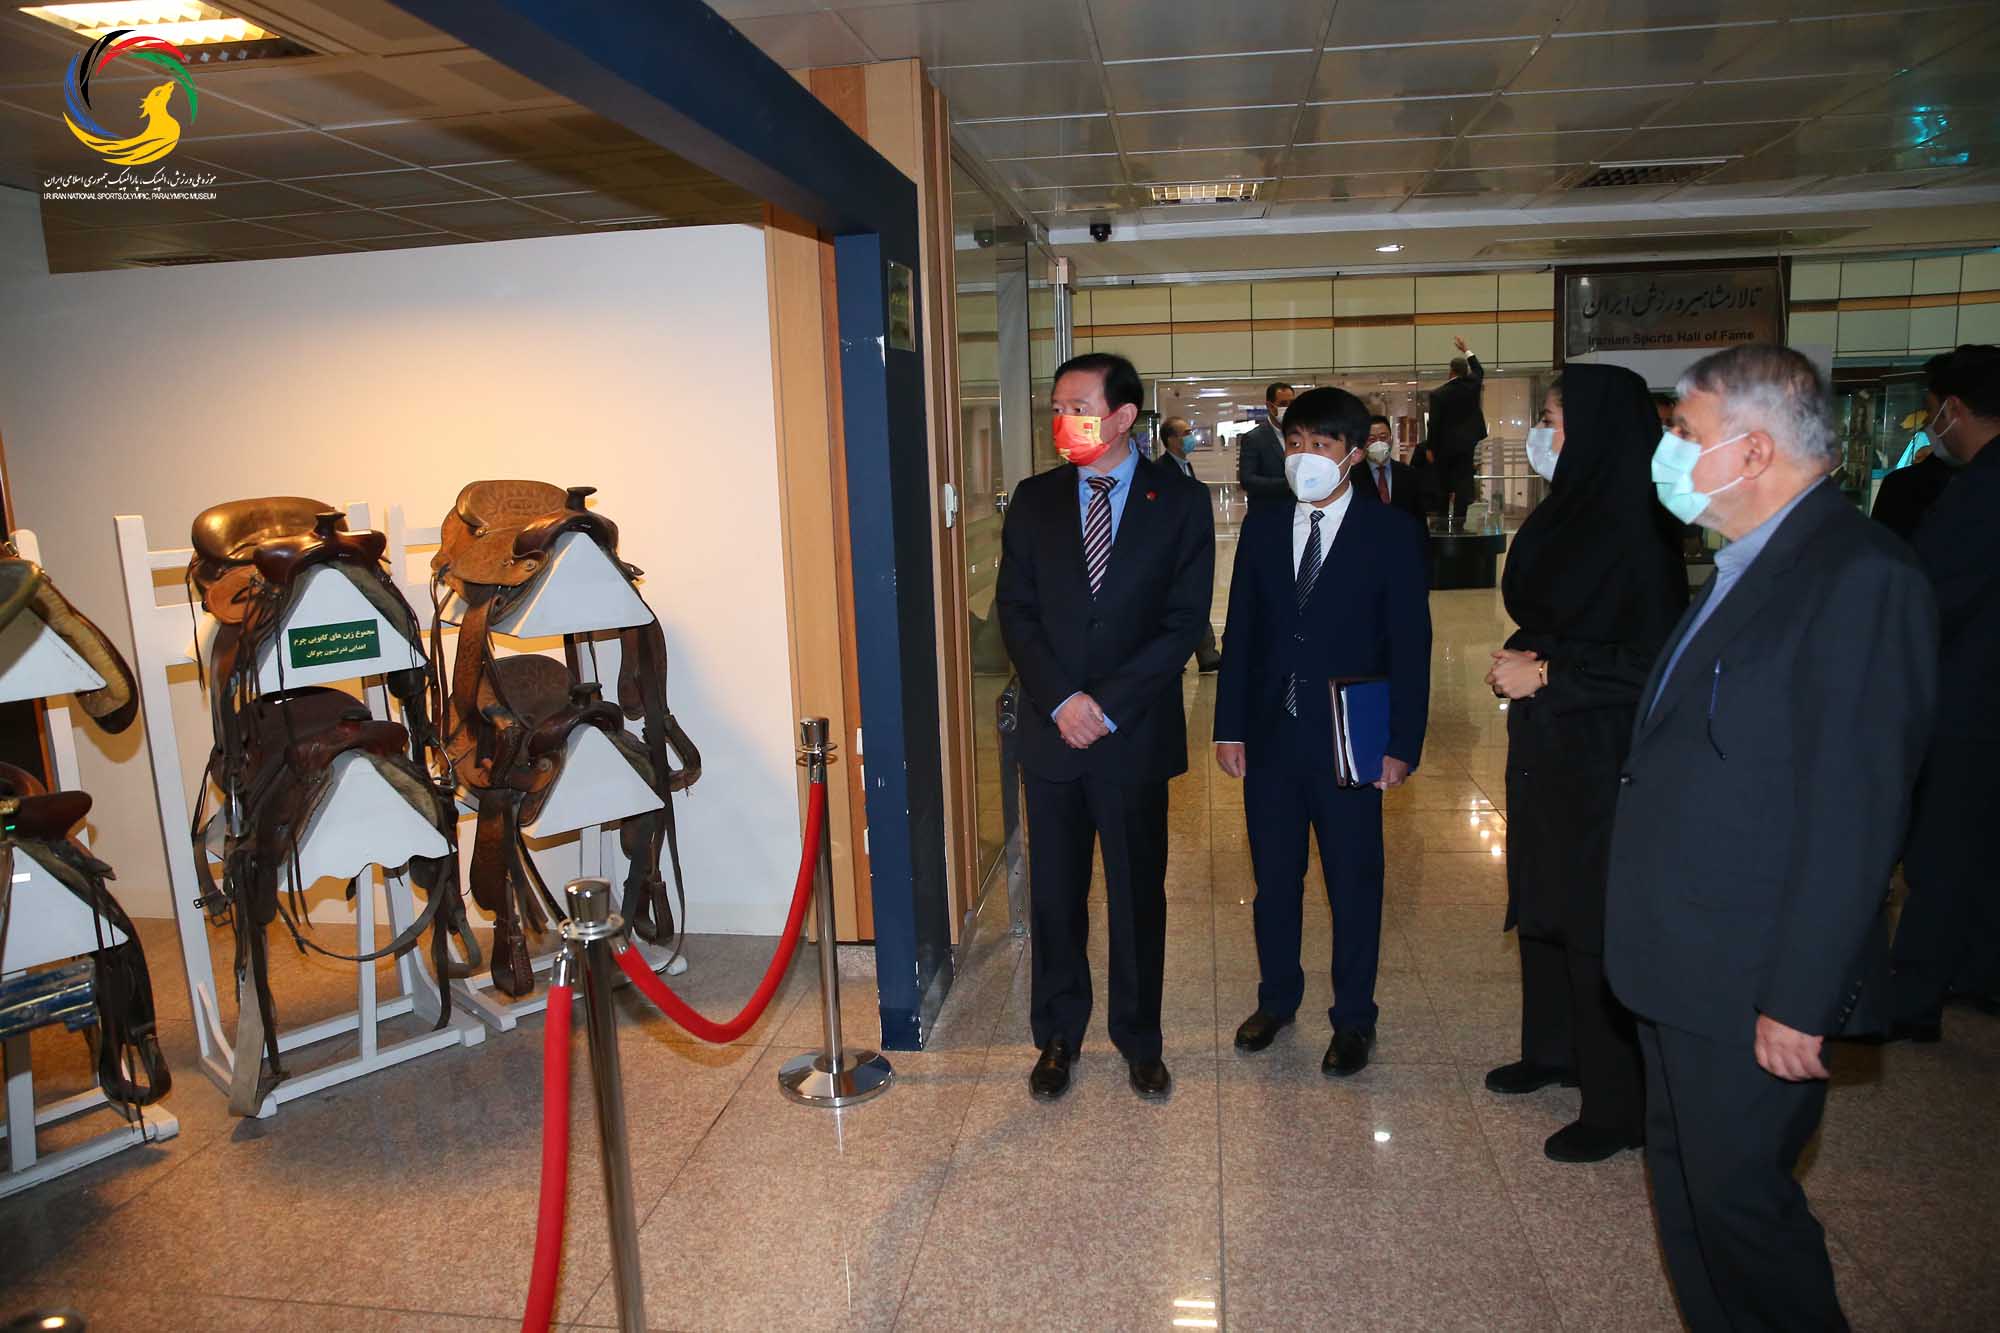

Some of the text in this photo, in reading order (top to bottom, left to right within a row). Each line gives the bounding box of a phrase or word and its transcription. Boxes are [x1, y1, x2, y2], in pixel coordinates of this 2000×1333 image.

[1633, 332, 1673, 346] Sports
[1678, 331, 1701, 342] Hall
[1704, 330, 1718, 340] of
[1720, 330, 1754, 340] Fame
